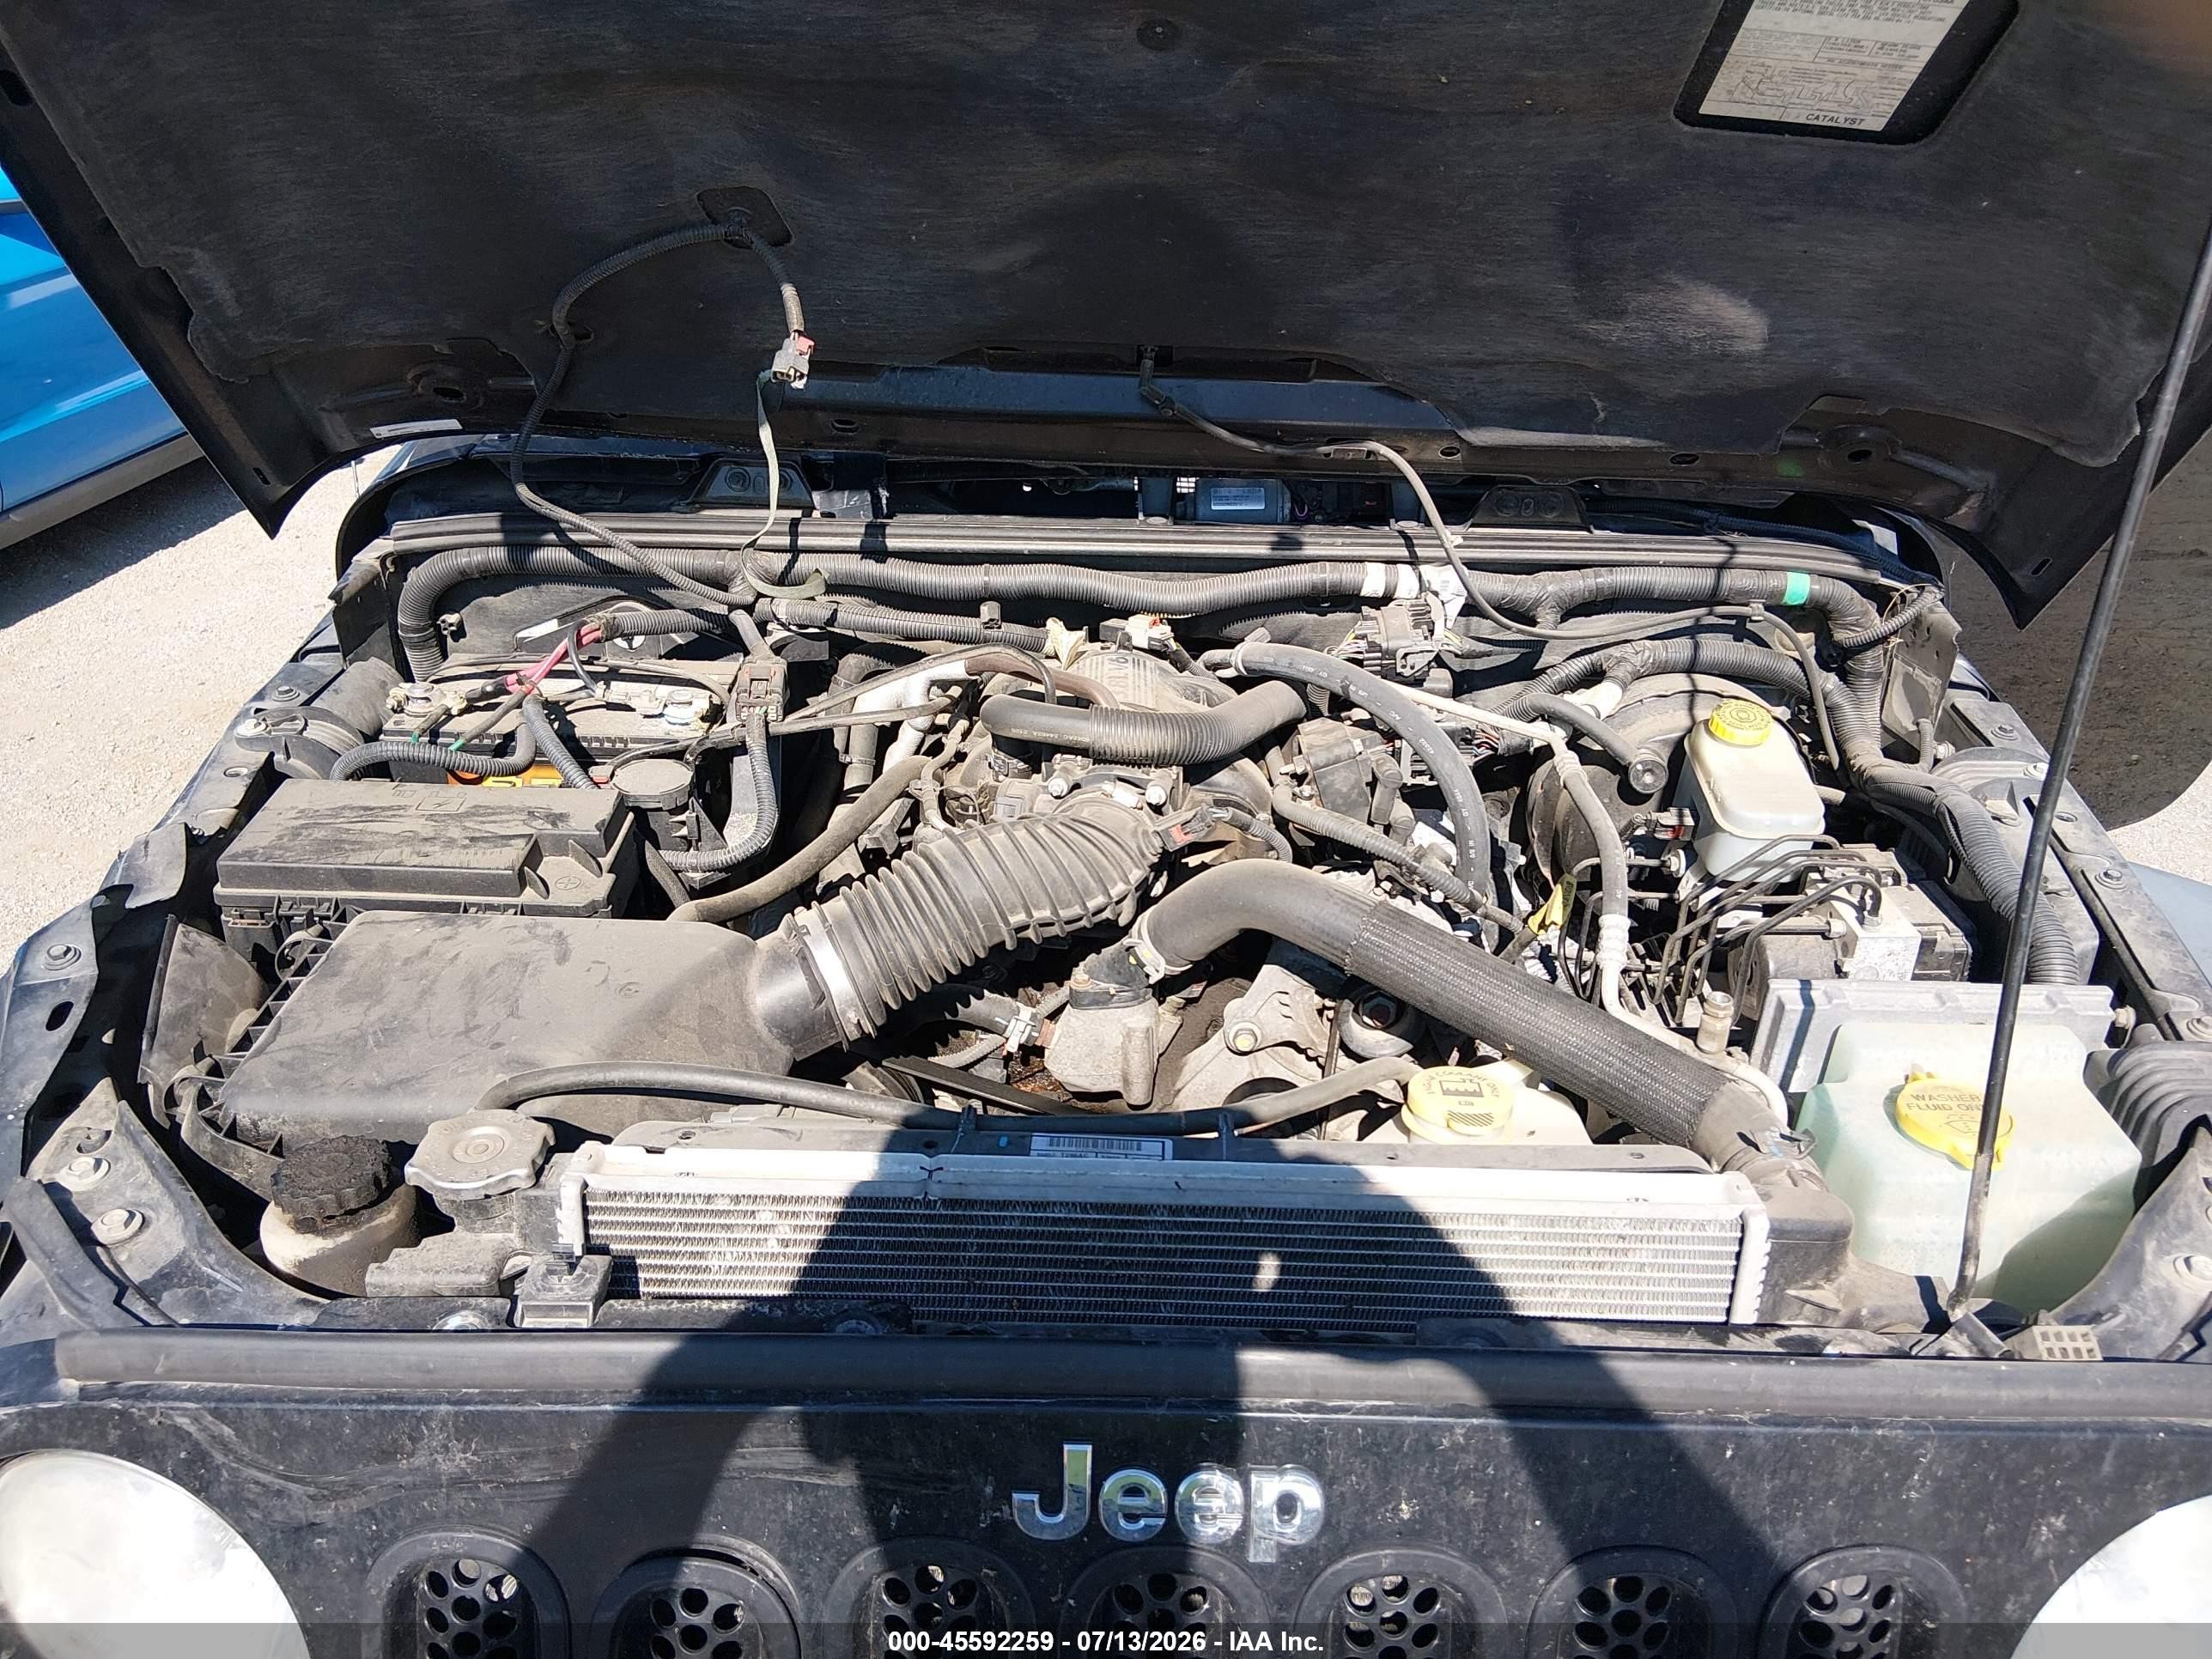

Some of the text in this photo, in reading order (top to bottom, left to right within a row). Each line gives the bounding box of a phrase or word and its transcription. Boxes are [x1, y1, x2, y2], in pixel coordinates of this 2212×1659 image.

[1806, 113, 1867, 125] CATALYST
[1910, 1093, 1981, 1102] WASHER
[1012, 1442, 1324, 1563] Jeep
